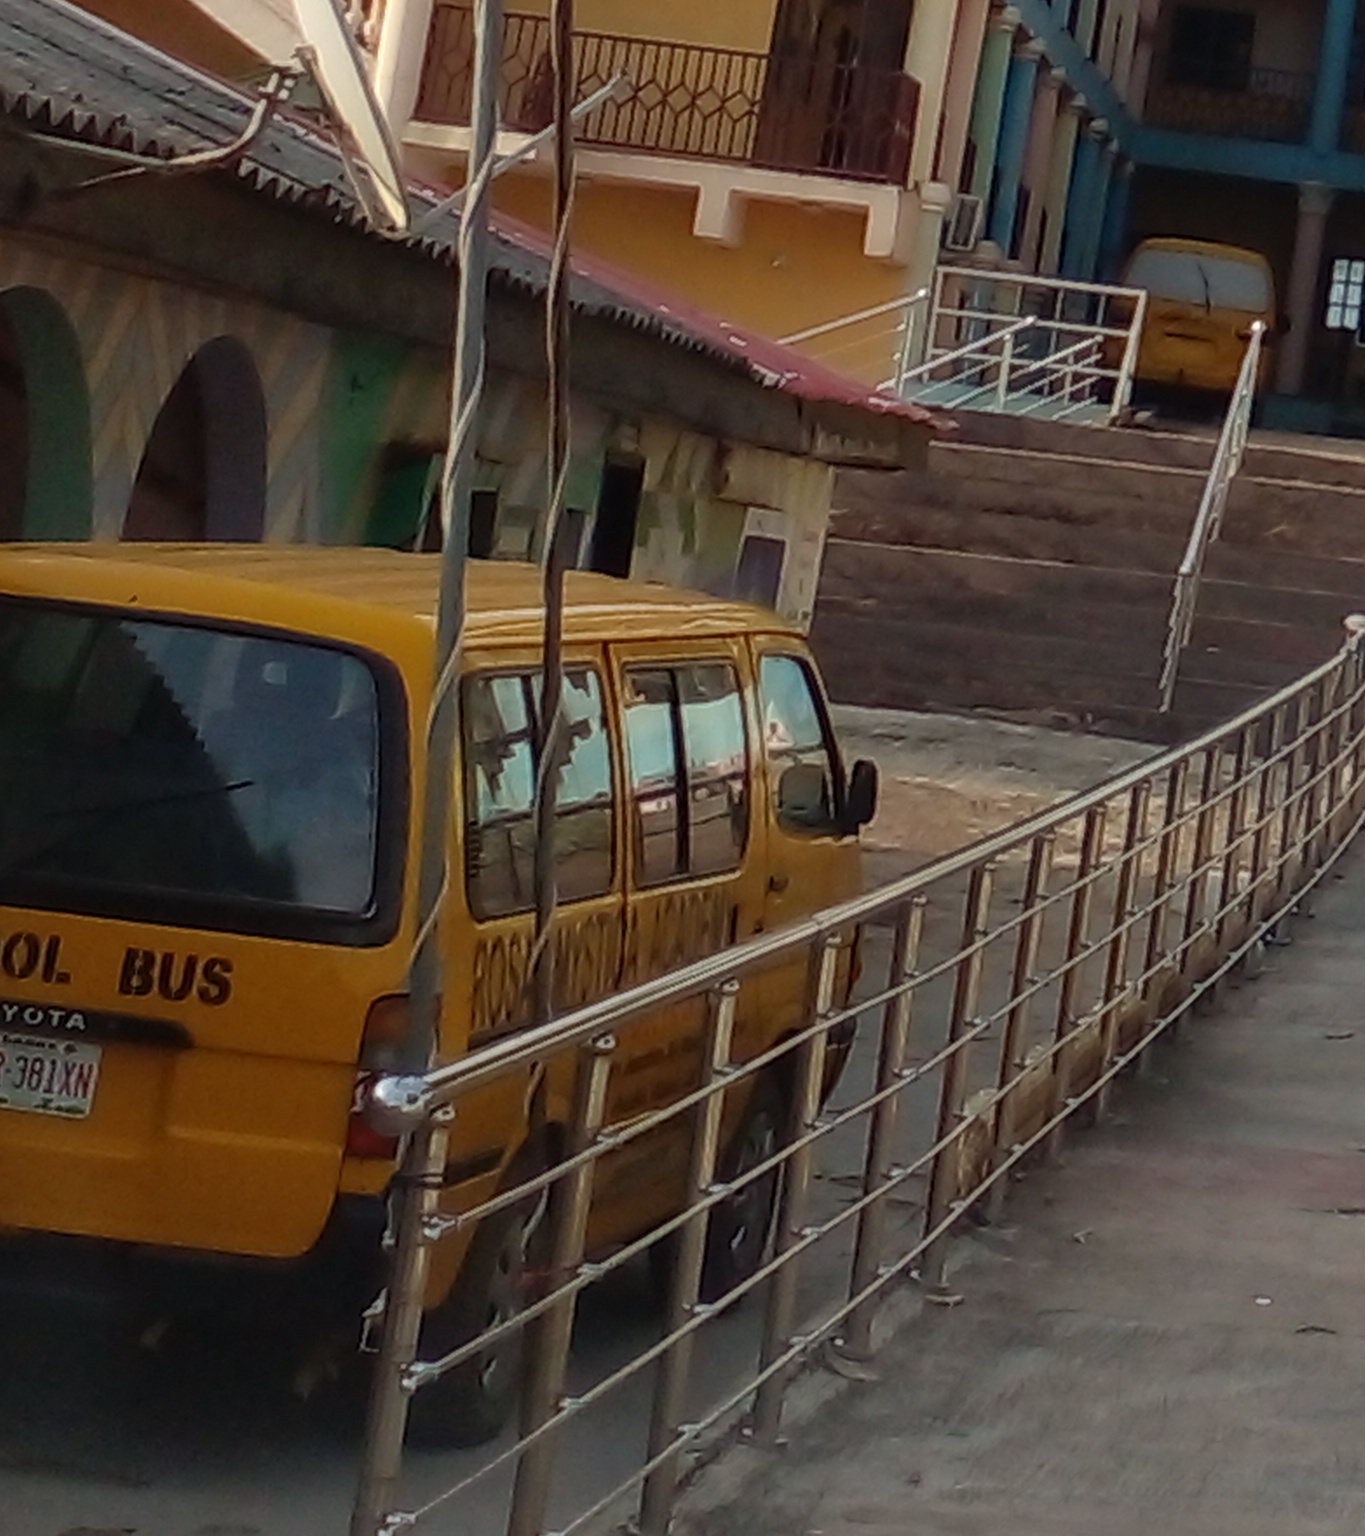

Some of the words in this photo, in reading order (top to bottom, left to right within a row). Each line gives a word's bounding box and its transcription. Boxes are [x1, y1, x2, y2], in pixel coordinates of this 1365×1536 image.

[0, 930, 71, 985] OL
[117, 946, 235, 1007] BUS
[2, 1002, 87, 1031] YOTA
